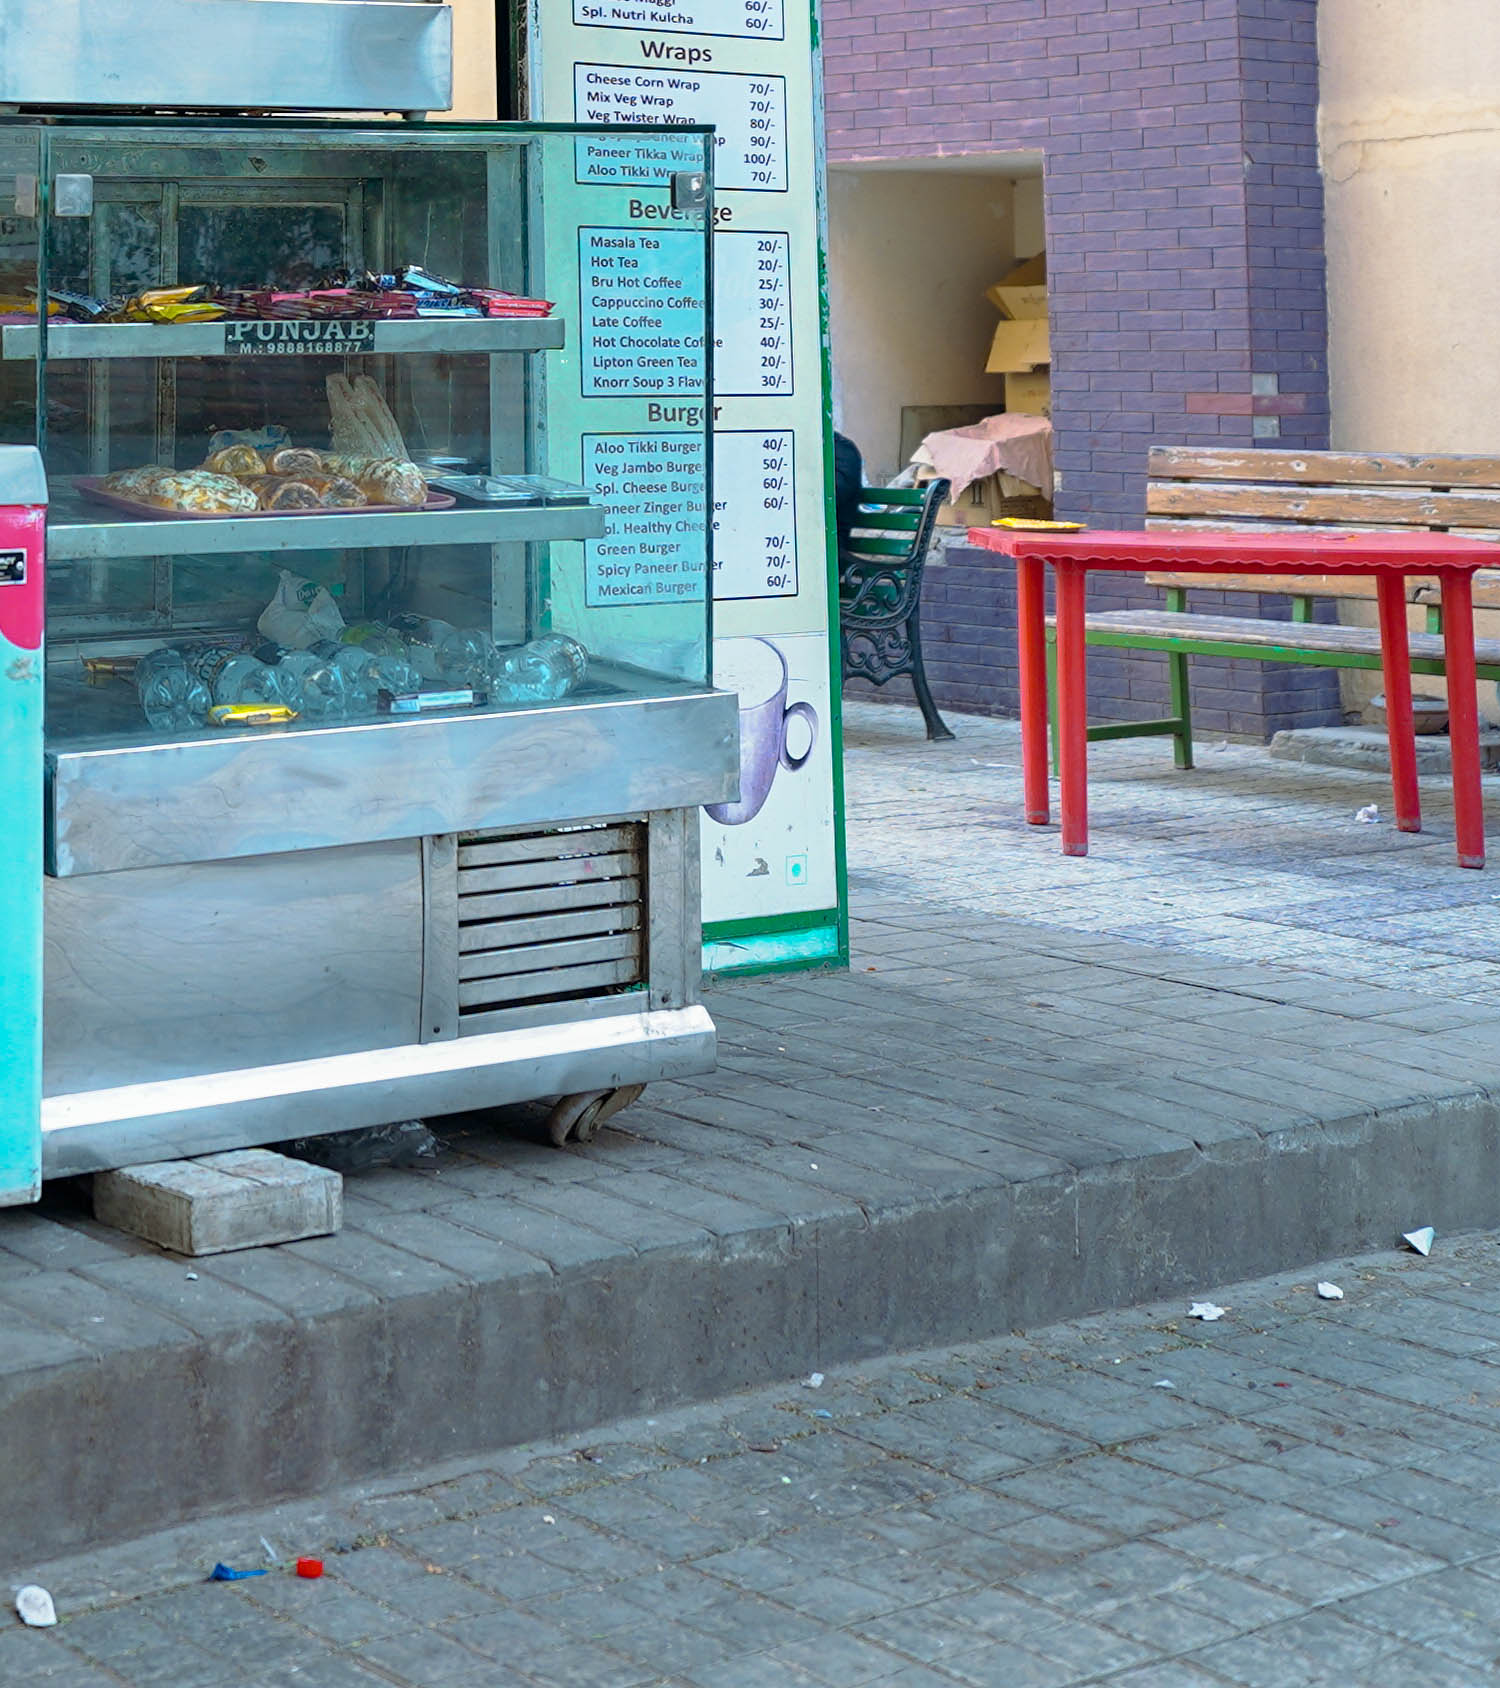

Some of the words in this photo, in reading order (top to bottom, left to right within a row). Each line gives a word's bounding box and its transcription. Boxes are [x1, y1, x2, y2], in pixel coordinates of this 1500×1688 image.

[639, 39, 712, 65] Wraps
[586, 72, 631, 86] Cheese
[634, 76, 663, 87] Corn
[667, 78, 700, 92] Wrap
[749, 83, 774, 96] 70/-
[267, 342, 361, 354] 9888168877
